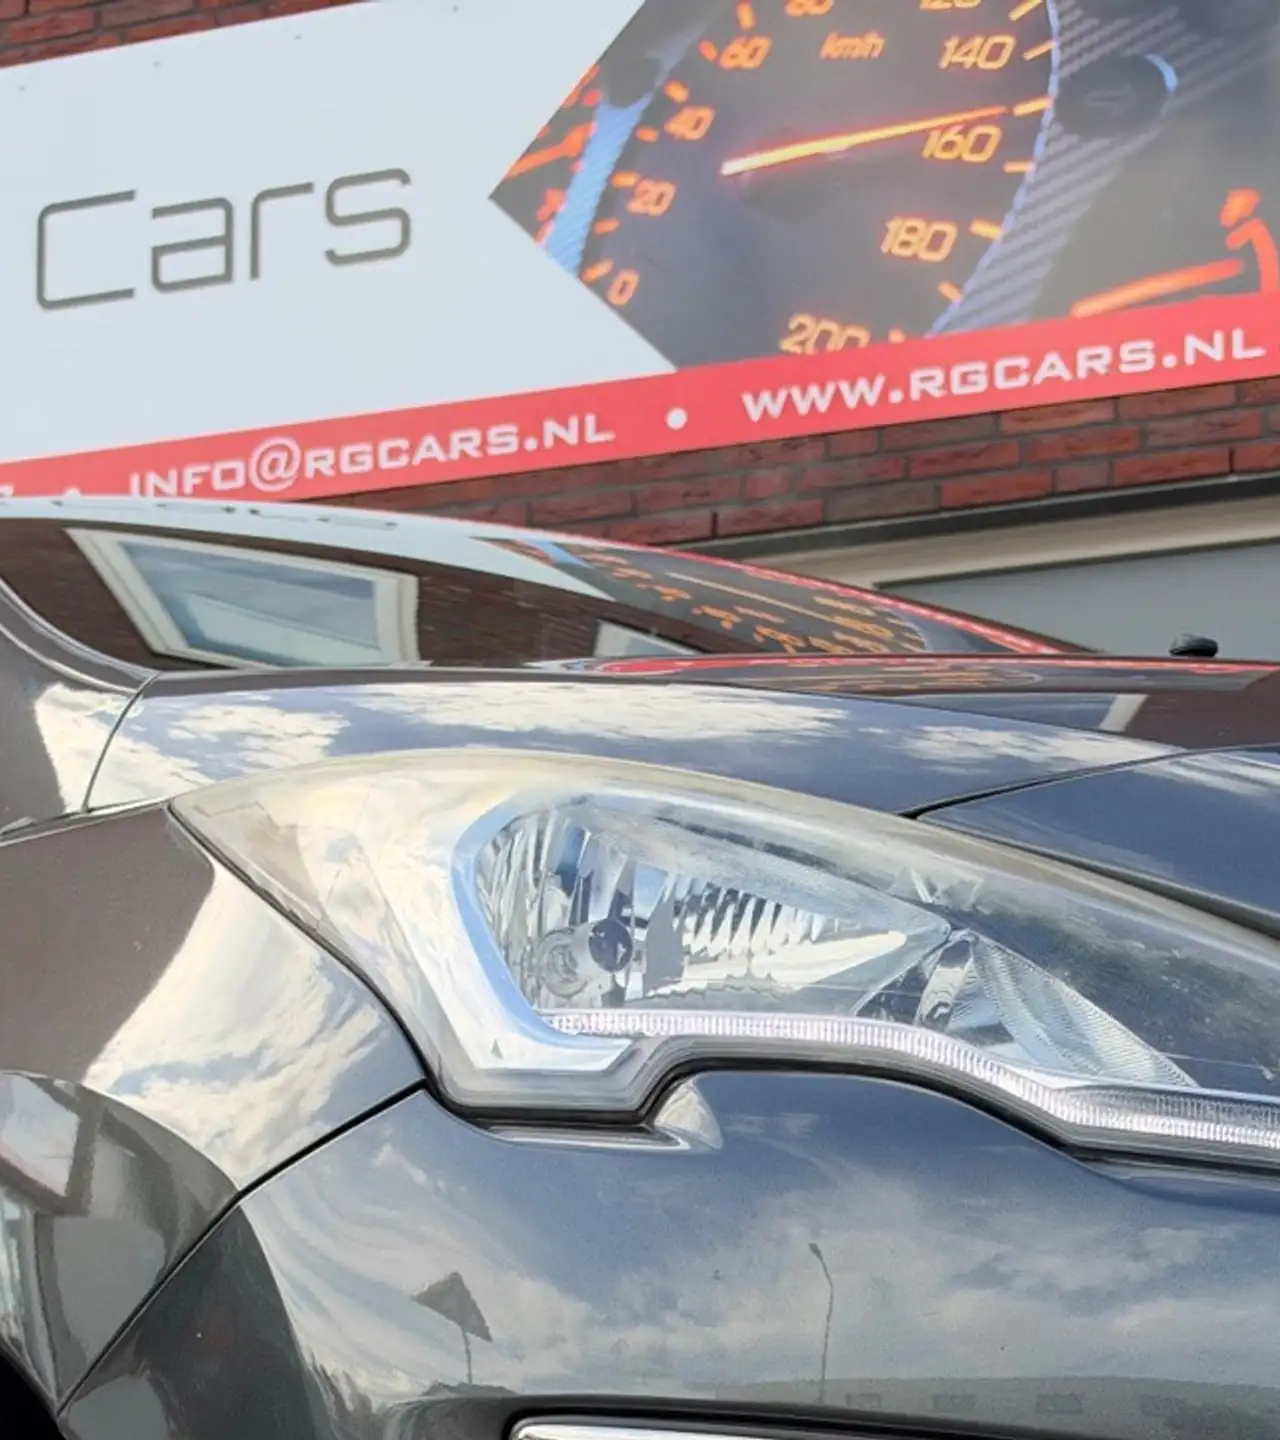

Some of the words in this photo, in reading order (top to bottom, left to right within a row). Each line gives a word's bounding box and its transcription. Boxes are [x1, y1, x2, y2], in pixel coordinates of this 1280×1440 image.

[720, 36, 772, 69] 60
[938, 34, 1015, 70] 140
[664, 106, 714, 141] 40
[922, 124, 1001, 164] 160
[628, 180, 676, 216] 20
[36, 167, 412, 312] Cars
[881, 217, 957, 262] 180
[608, 270, 639, 306] 0
[742, 327, 1267, 423] WWW.RGCARS.NL
[128, 413, 616, 498] INFO@RGCARS.NL
